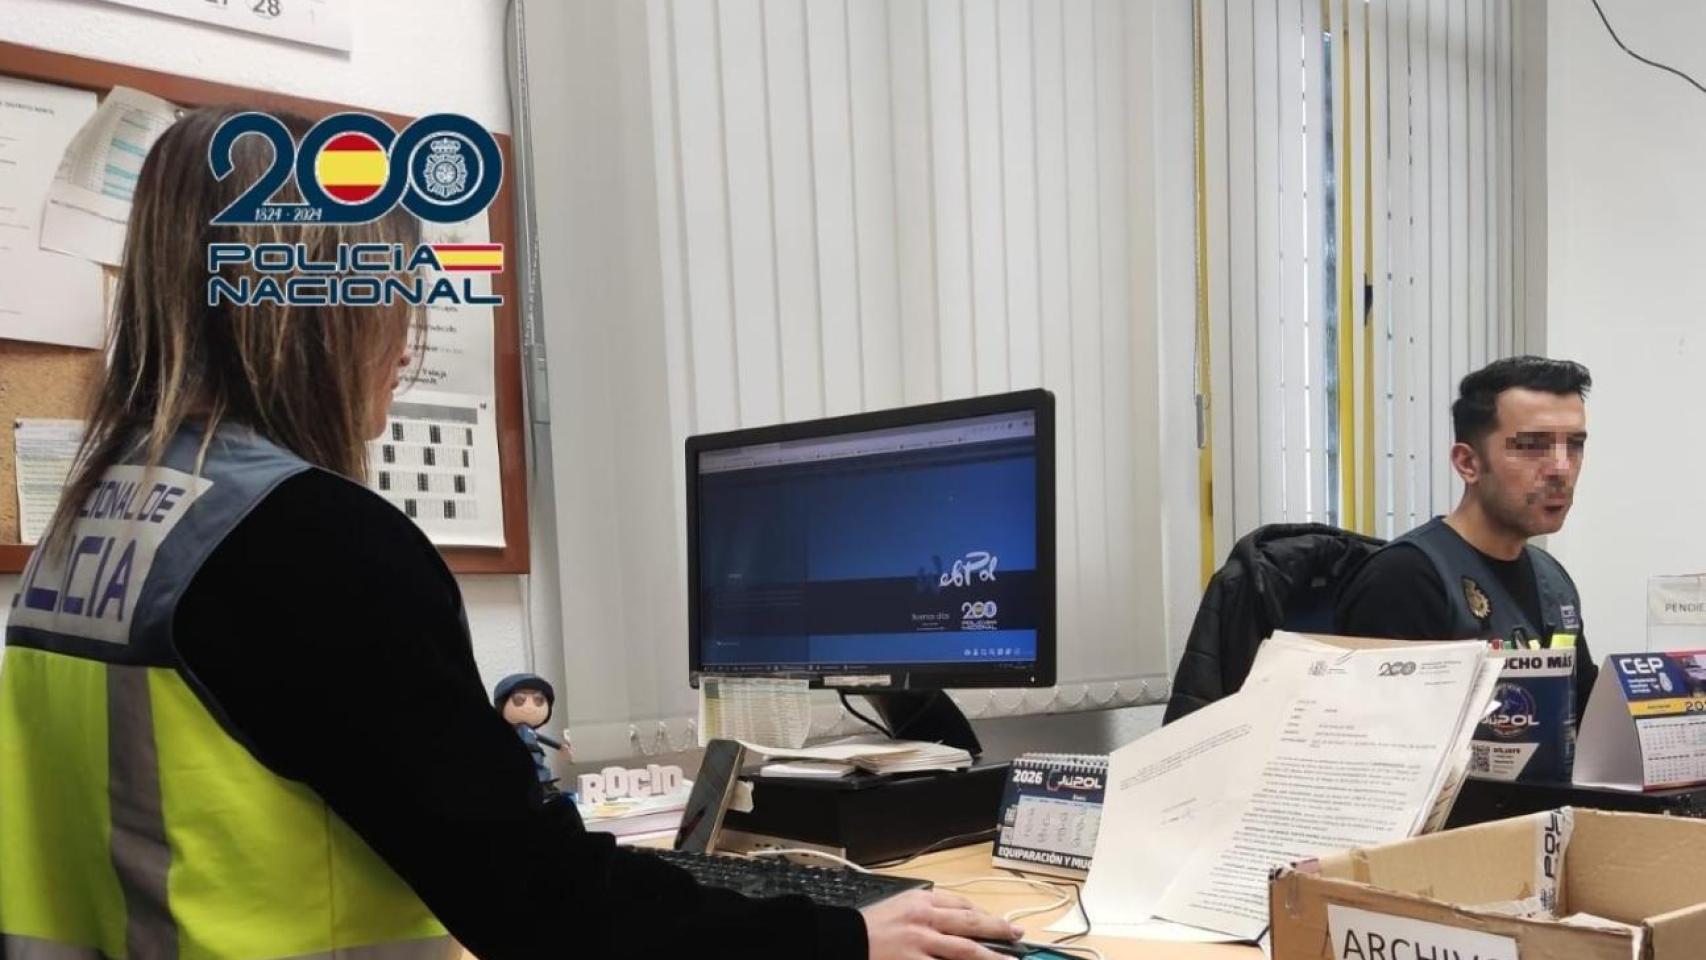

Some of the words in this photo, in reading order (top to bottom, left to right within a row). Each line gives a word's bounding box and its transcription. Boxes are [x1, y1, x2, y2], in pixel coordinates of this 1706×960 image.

[137, 482, 185, 523] DE
[1619, 657, 1664, 674] CEP
[1013, 769, 1043, 785] 2026
[999, 846, 1063, 864] EQUIPARACIÓN
